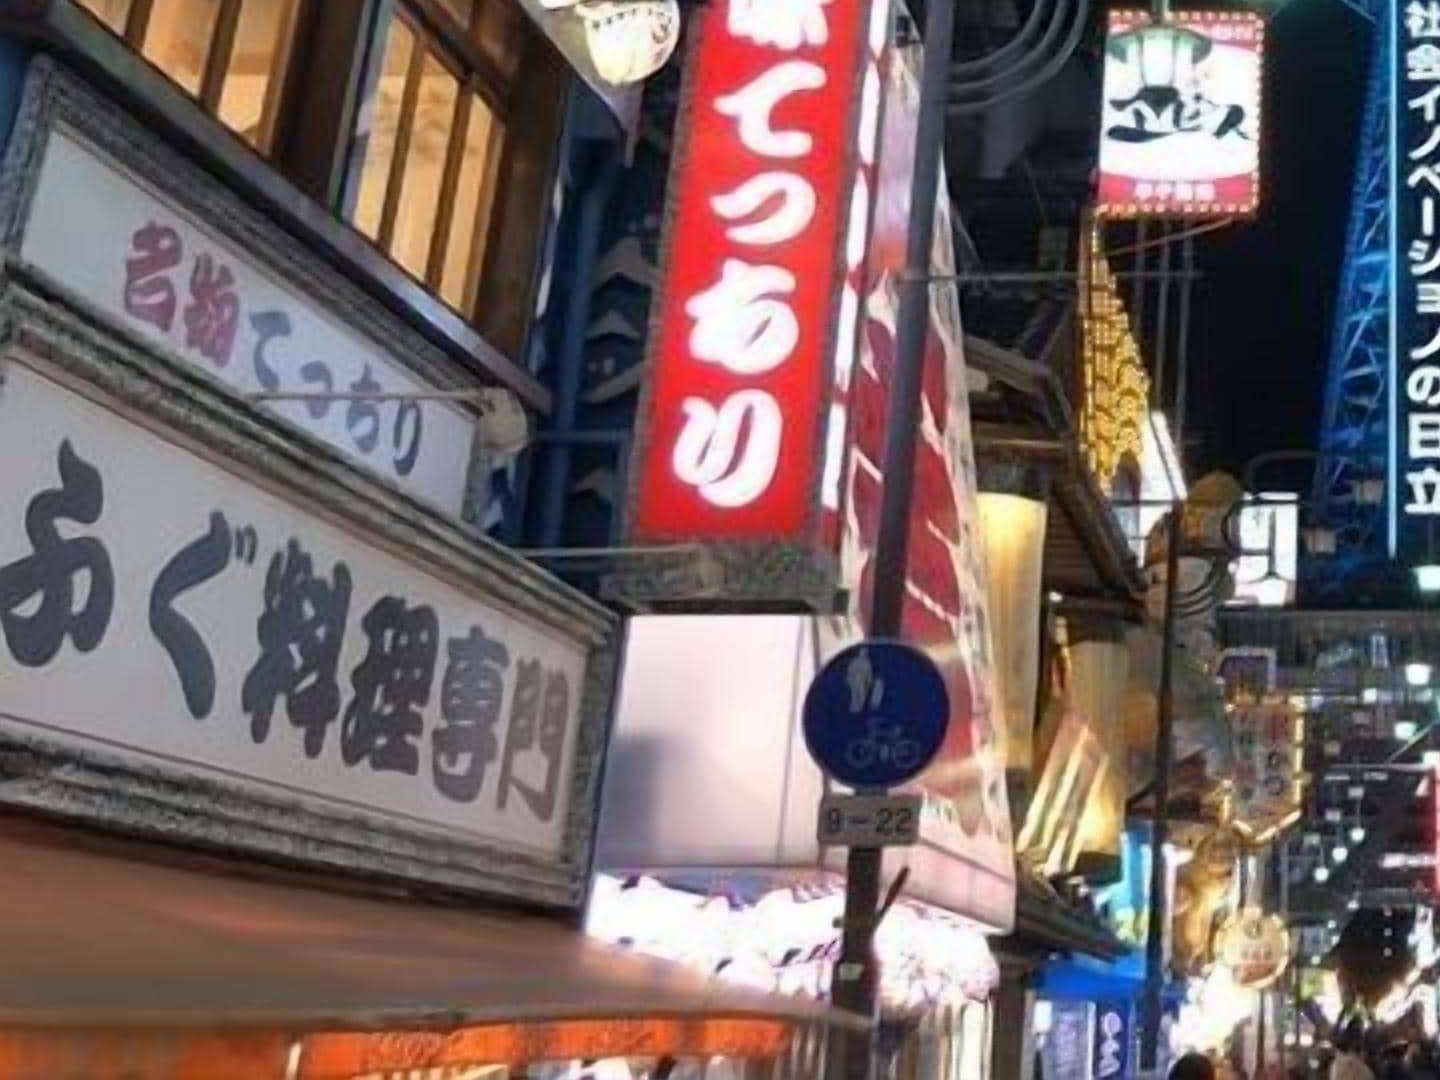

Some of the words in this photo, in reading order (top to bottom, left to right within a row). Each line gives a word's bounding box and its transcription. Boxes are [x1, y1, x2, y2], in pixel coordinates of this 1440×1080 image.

[0, 437, 569, 822] ふぐ料理専門
